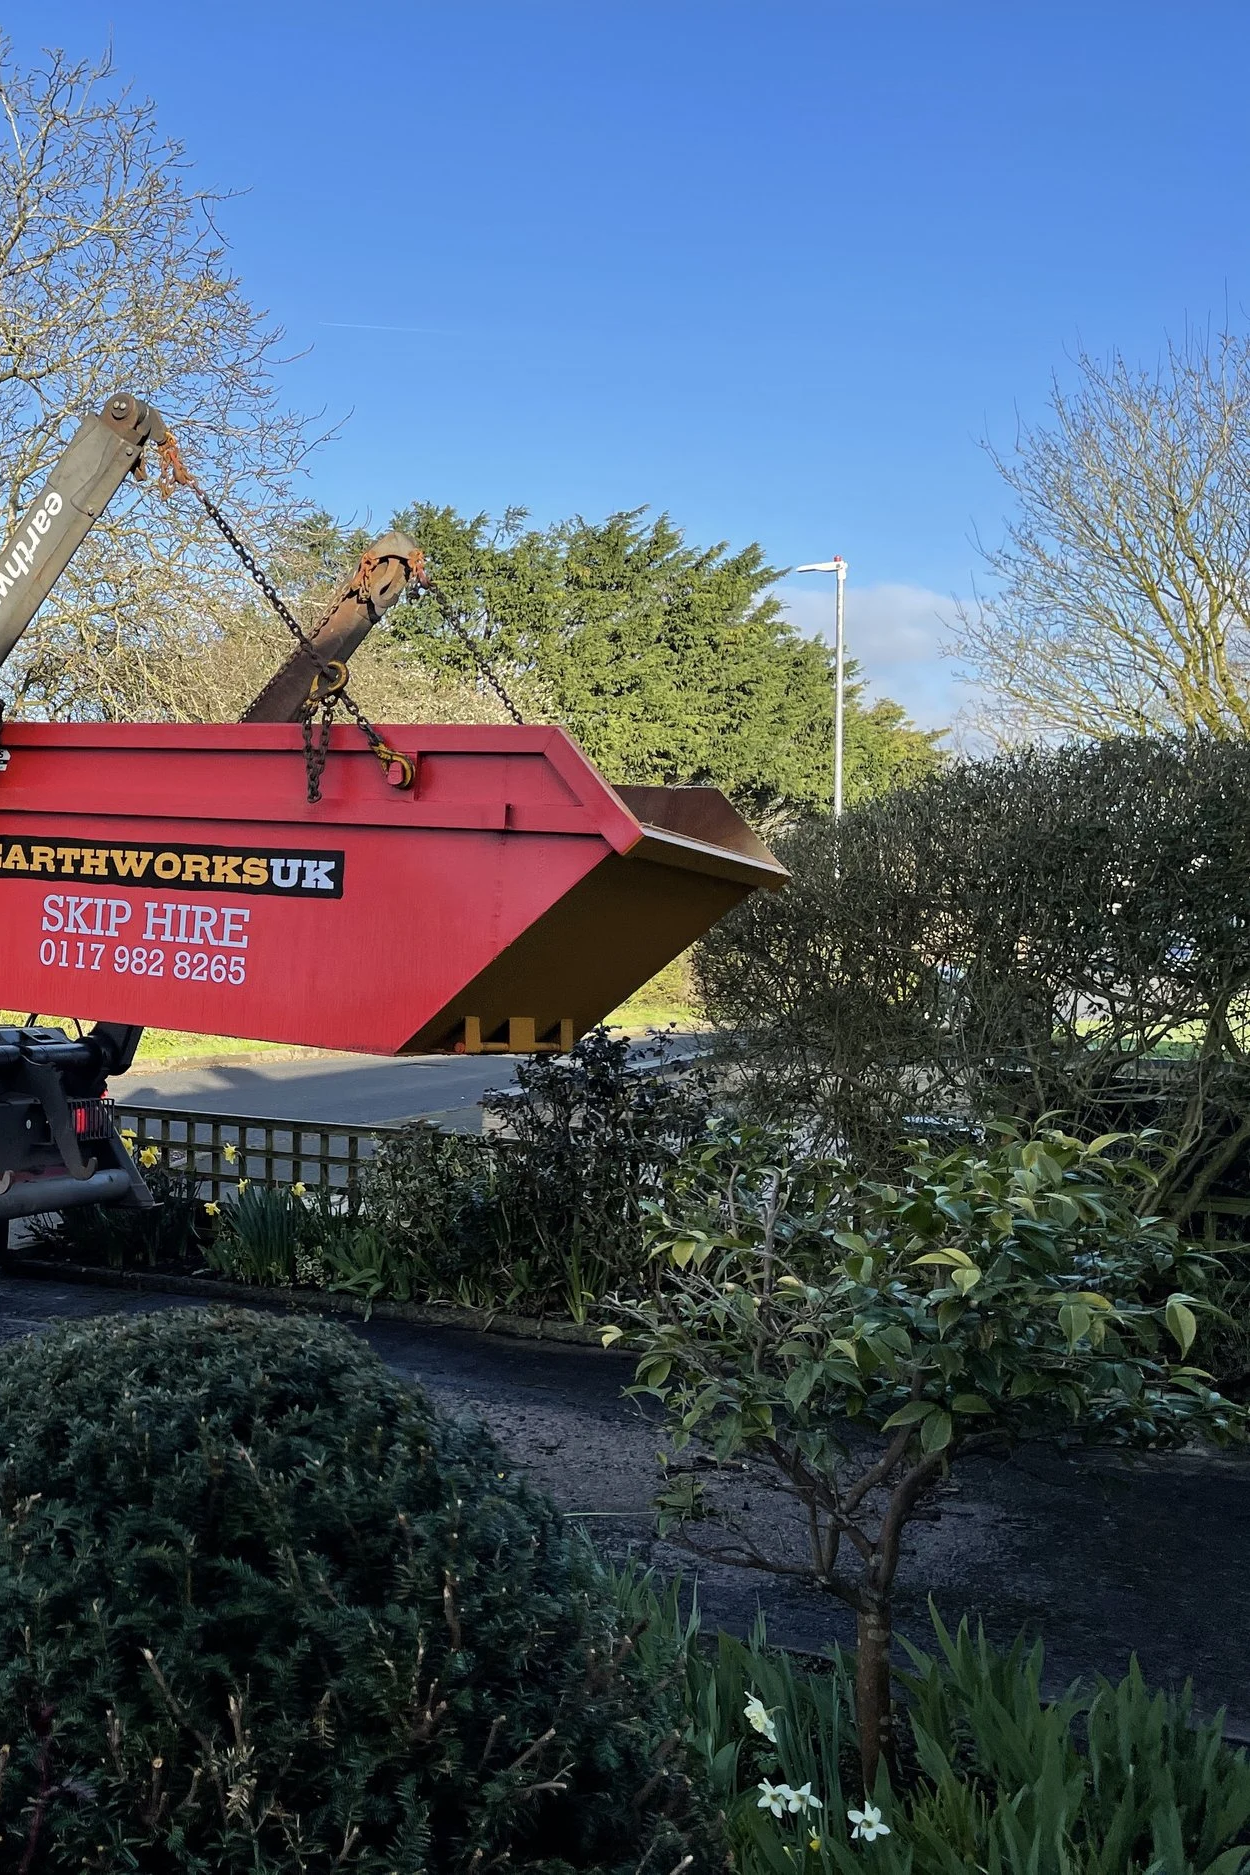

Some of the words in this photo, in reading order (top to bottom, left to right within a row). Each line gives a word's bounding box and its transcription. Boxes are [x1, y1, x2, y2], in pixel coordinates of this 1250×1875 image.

[41, 894, 132, 938] SKIP
[142, 901, 250, 949] HIRE
[39, 938, 106, 972] 0117
[113, 945, 165, 978] 982
[173, 950, 247, 986] 8265
